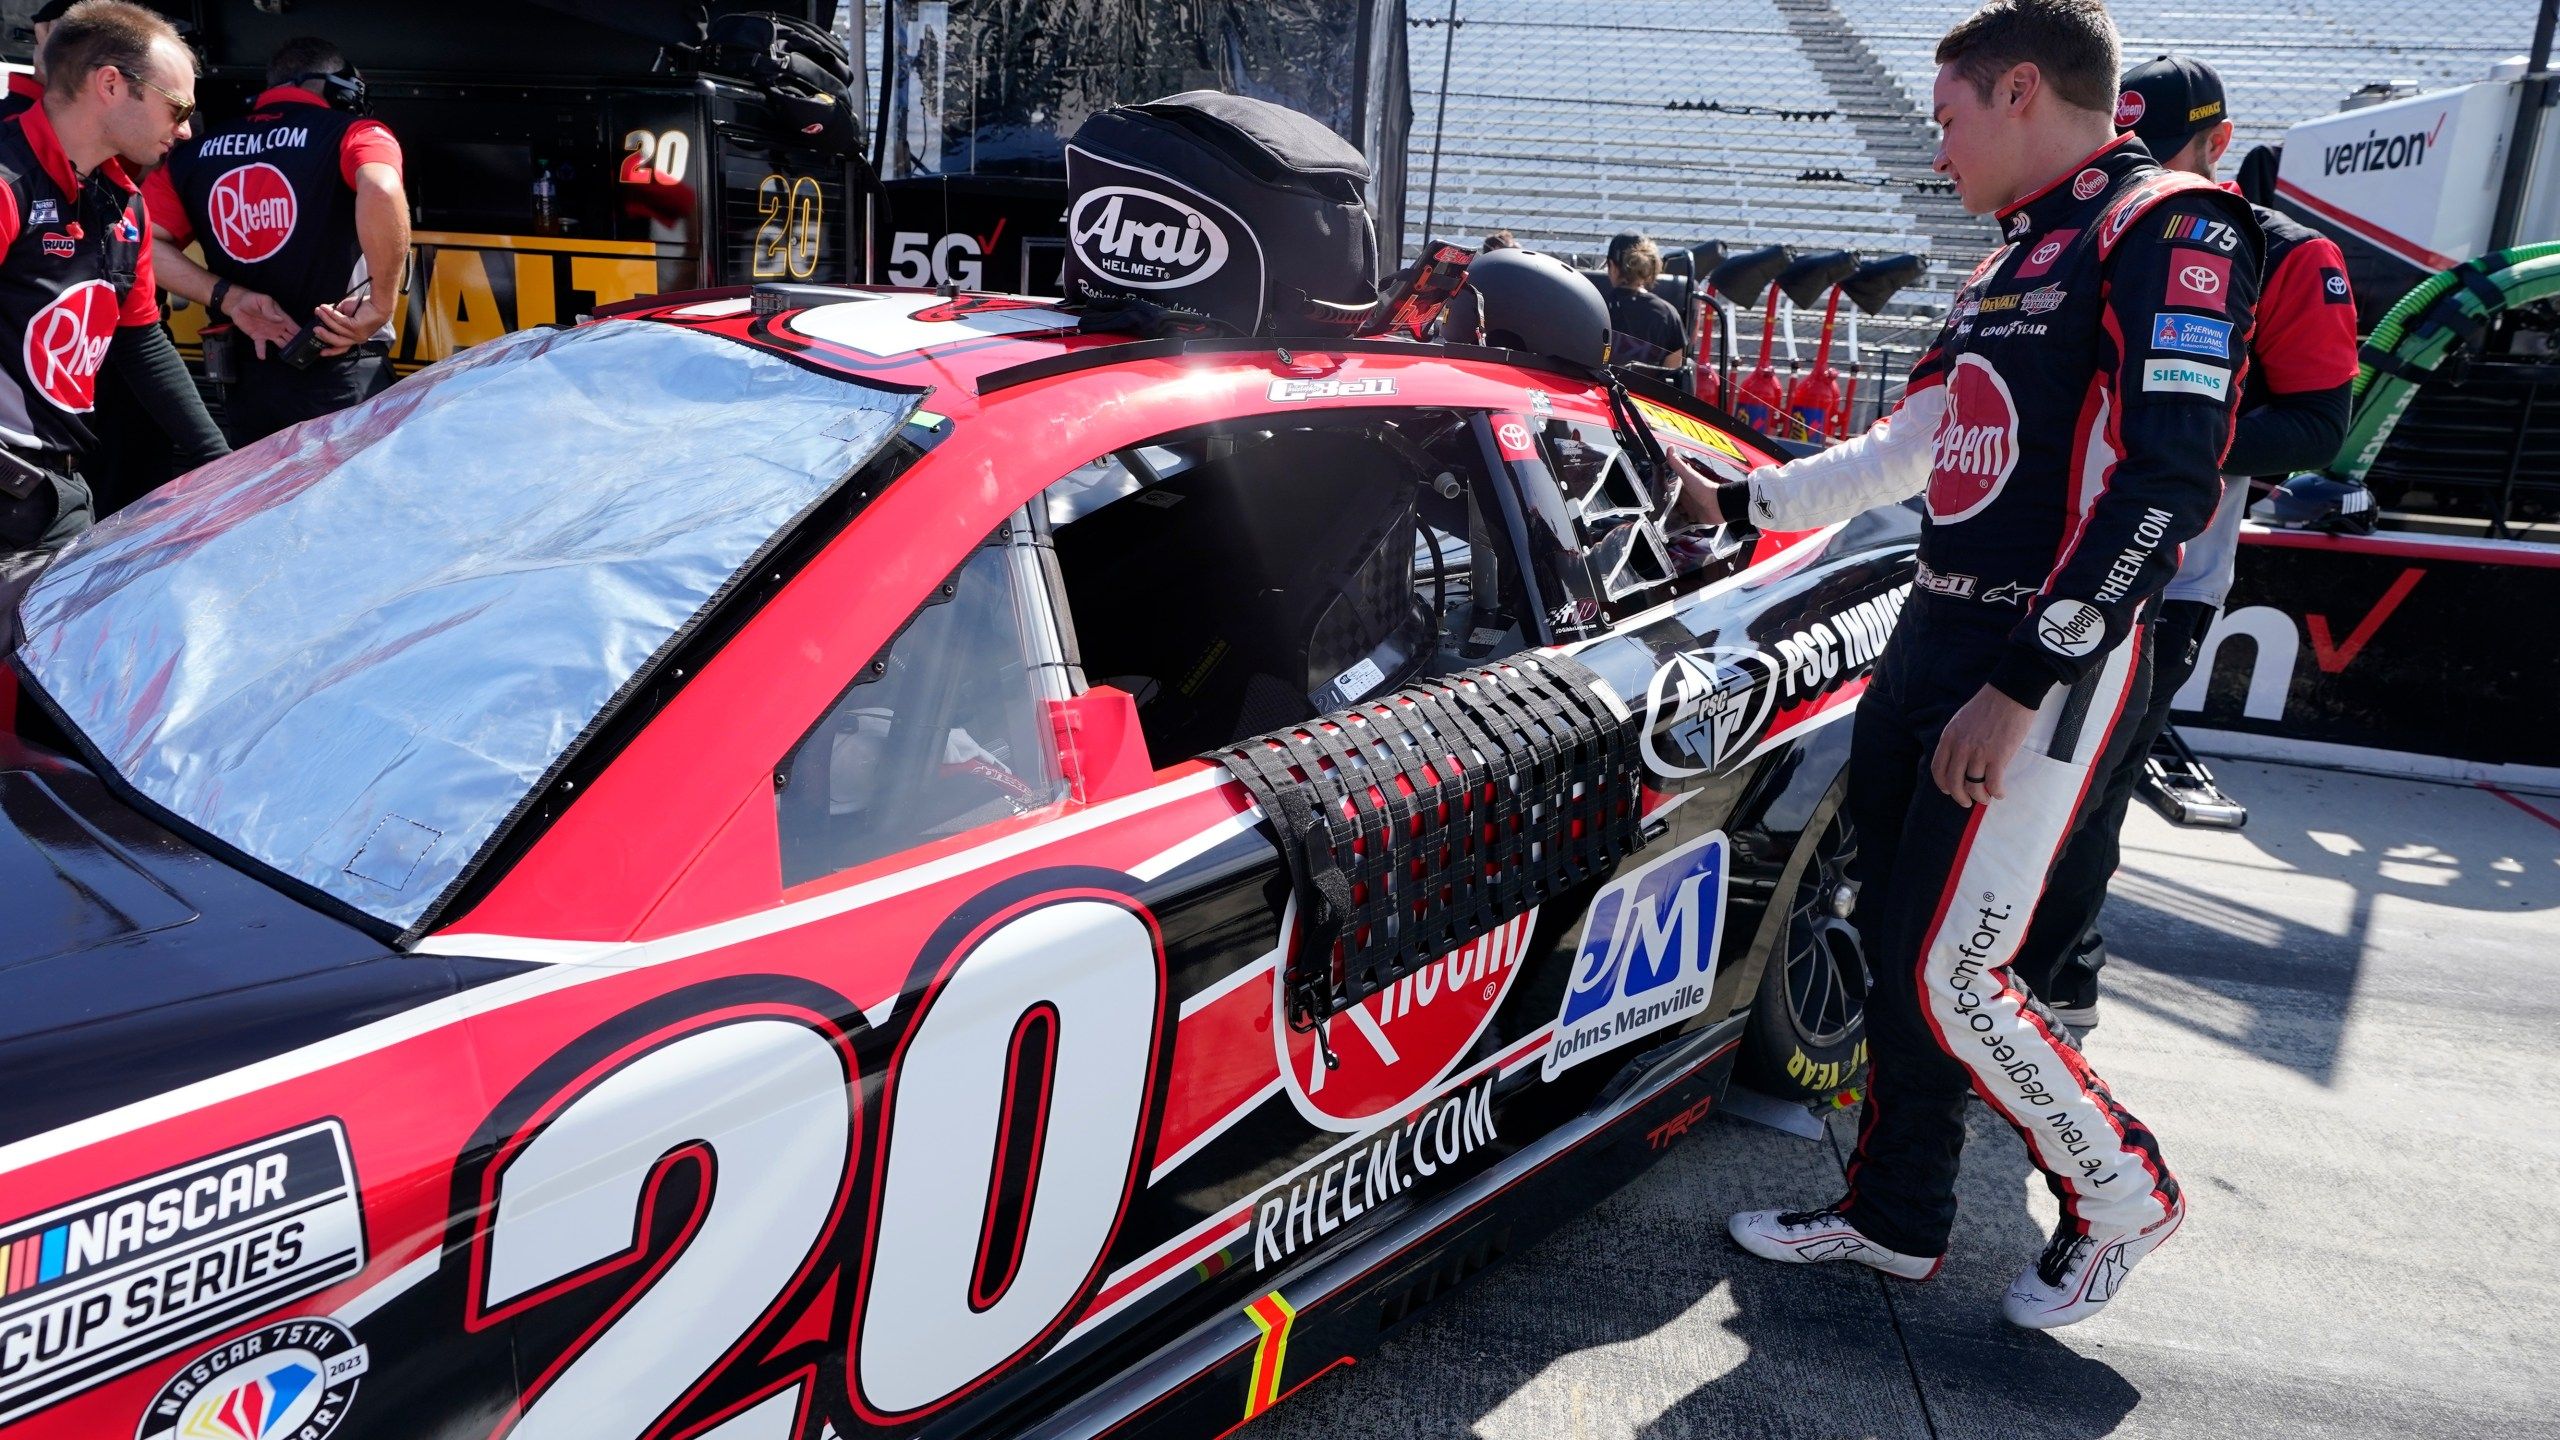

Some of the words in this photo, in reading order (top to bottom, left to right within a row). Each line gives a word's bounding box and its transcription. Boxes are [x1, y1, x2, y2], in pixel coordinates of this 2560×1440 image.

[199, 127, 308, 158] RHEEM.COM
[620, 130, 689, 185] 20
[2324, 128, 2425, 176] verizon
[217, 170, 289, 247] Rheem
[2076, 173, 2107, 198] Rheem
[44, 240, 74, 251] RUUD
[753, 175, 822, 278] 20
[1074, 195, 1206, 267] Arai
[2204, 221, 2238, 251] 75
[887, 231, 983, 291] 5G
[1102, 258, 1166, 279] HELMET
[2183, 323, 2224, 339] SHERWIN
[2152, 369, 2221, 390] SIEMENS
[2094, 507, 2174, 604] RHEEM.COM
[1774, 622, 1840, 697] PSC
[1830, 581, 1914, 670] INDUS
[2040, 604, 2101, 656] Rheem
[1698, 690, 1729, 722] PSC
[1573, 870, 1712, 997] JM
[1548, 1020, 1612, 1070] Johns
[1614, 984, 1705, 1037] Manville
[1646, 1095, 1712, 1150] TRD
[2047, 1112, 2090, 1157] new
[474, 890, 1170, 1440] 20
[1254, 1077, 1498, 1273] RHEEM.COM
[65, 1152, 288, 1276] NASCAR
[1, 1291, 112, 1371] CUP
[123, 1221, 305, 1328] SERIES
[157, 1335, 262, 1417] NASCAR
[271, 1323, 336, 1352] 75TH
[330, 1355, 362, 1377] 2023
